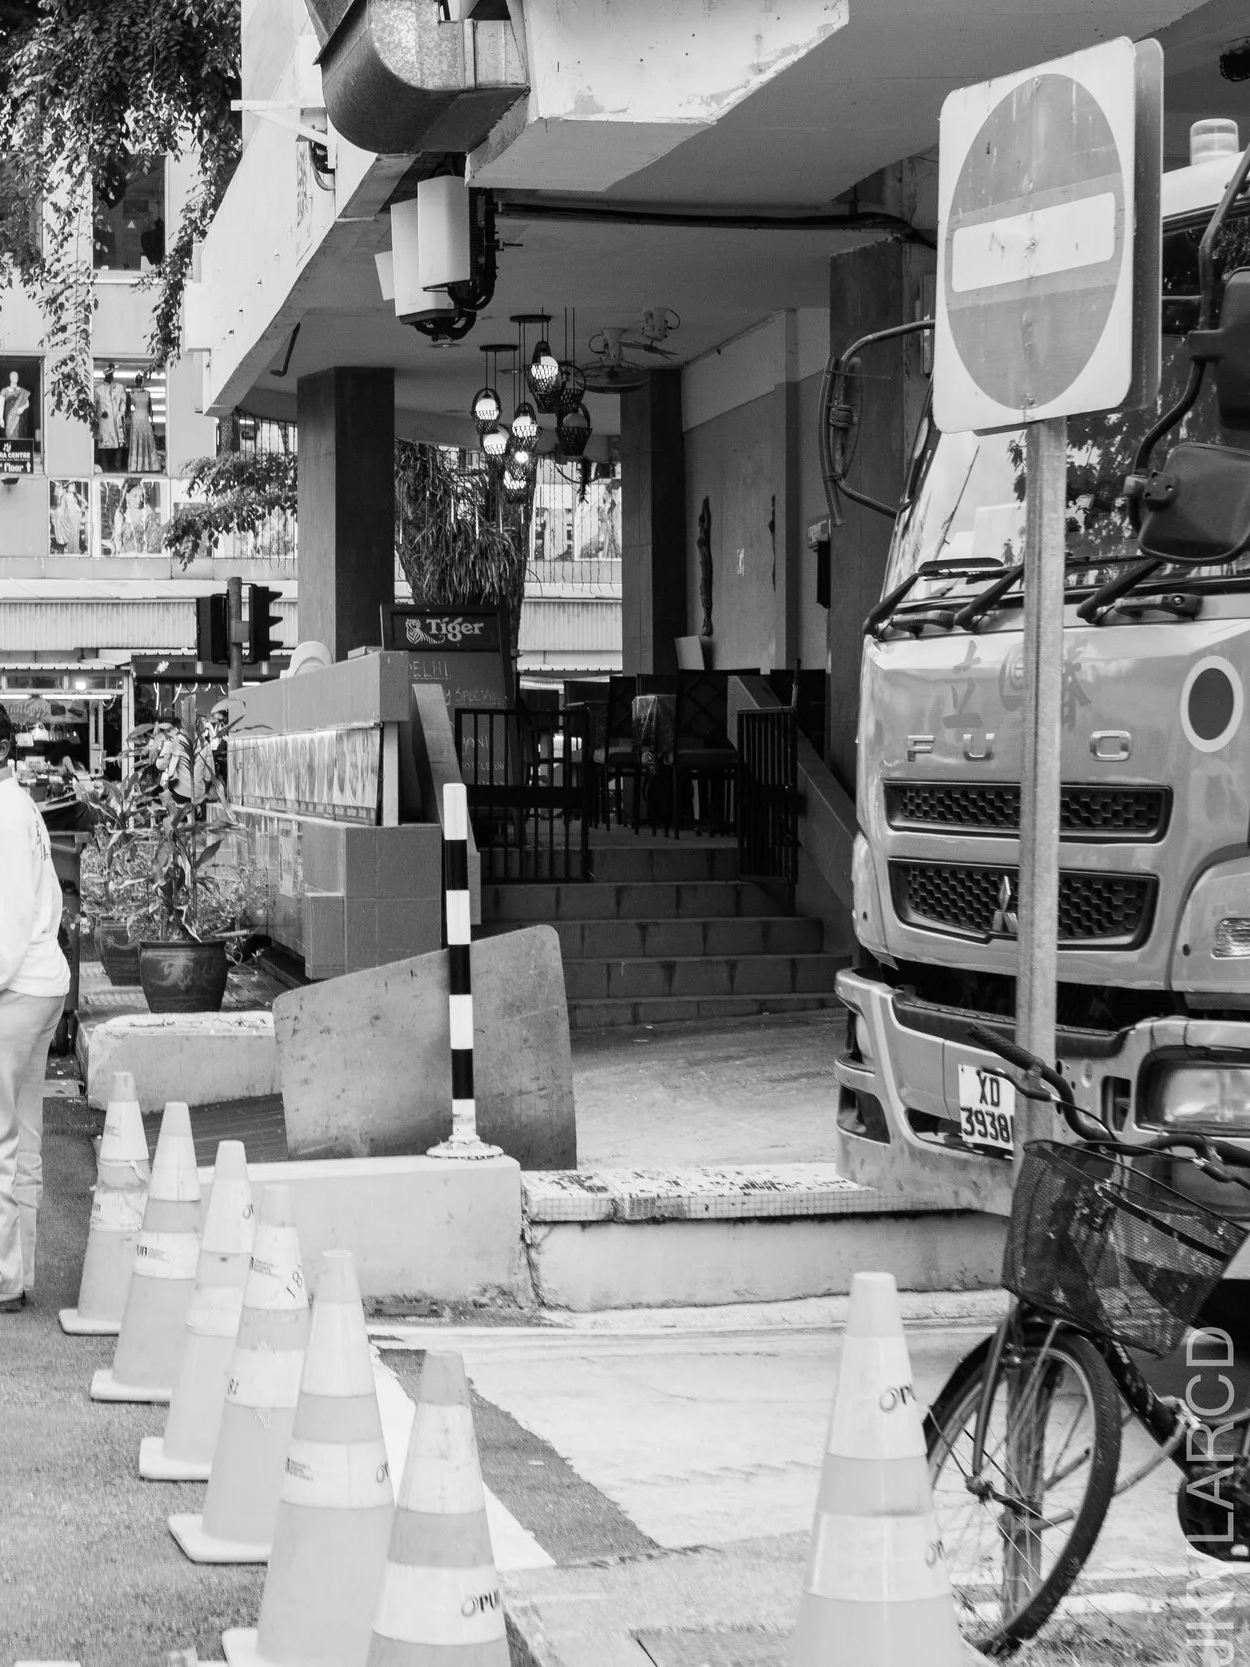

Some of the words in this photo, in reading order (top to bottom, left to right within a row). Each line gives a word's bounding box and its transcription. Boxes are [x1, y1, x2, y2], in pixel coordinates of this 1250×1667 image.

[426, 616, 485, 642] Tiger
[409, 660, 449, 678] ELHI
[906, 730, 1133, 763] FUO
[978, 1073, 1000, 1107] XD
